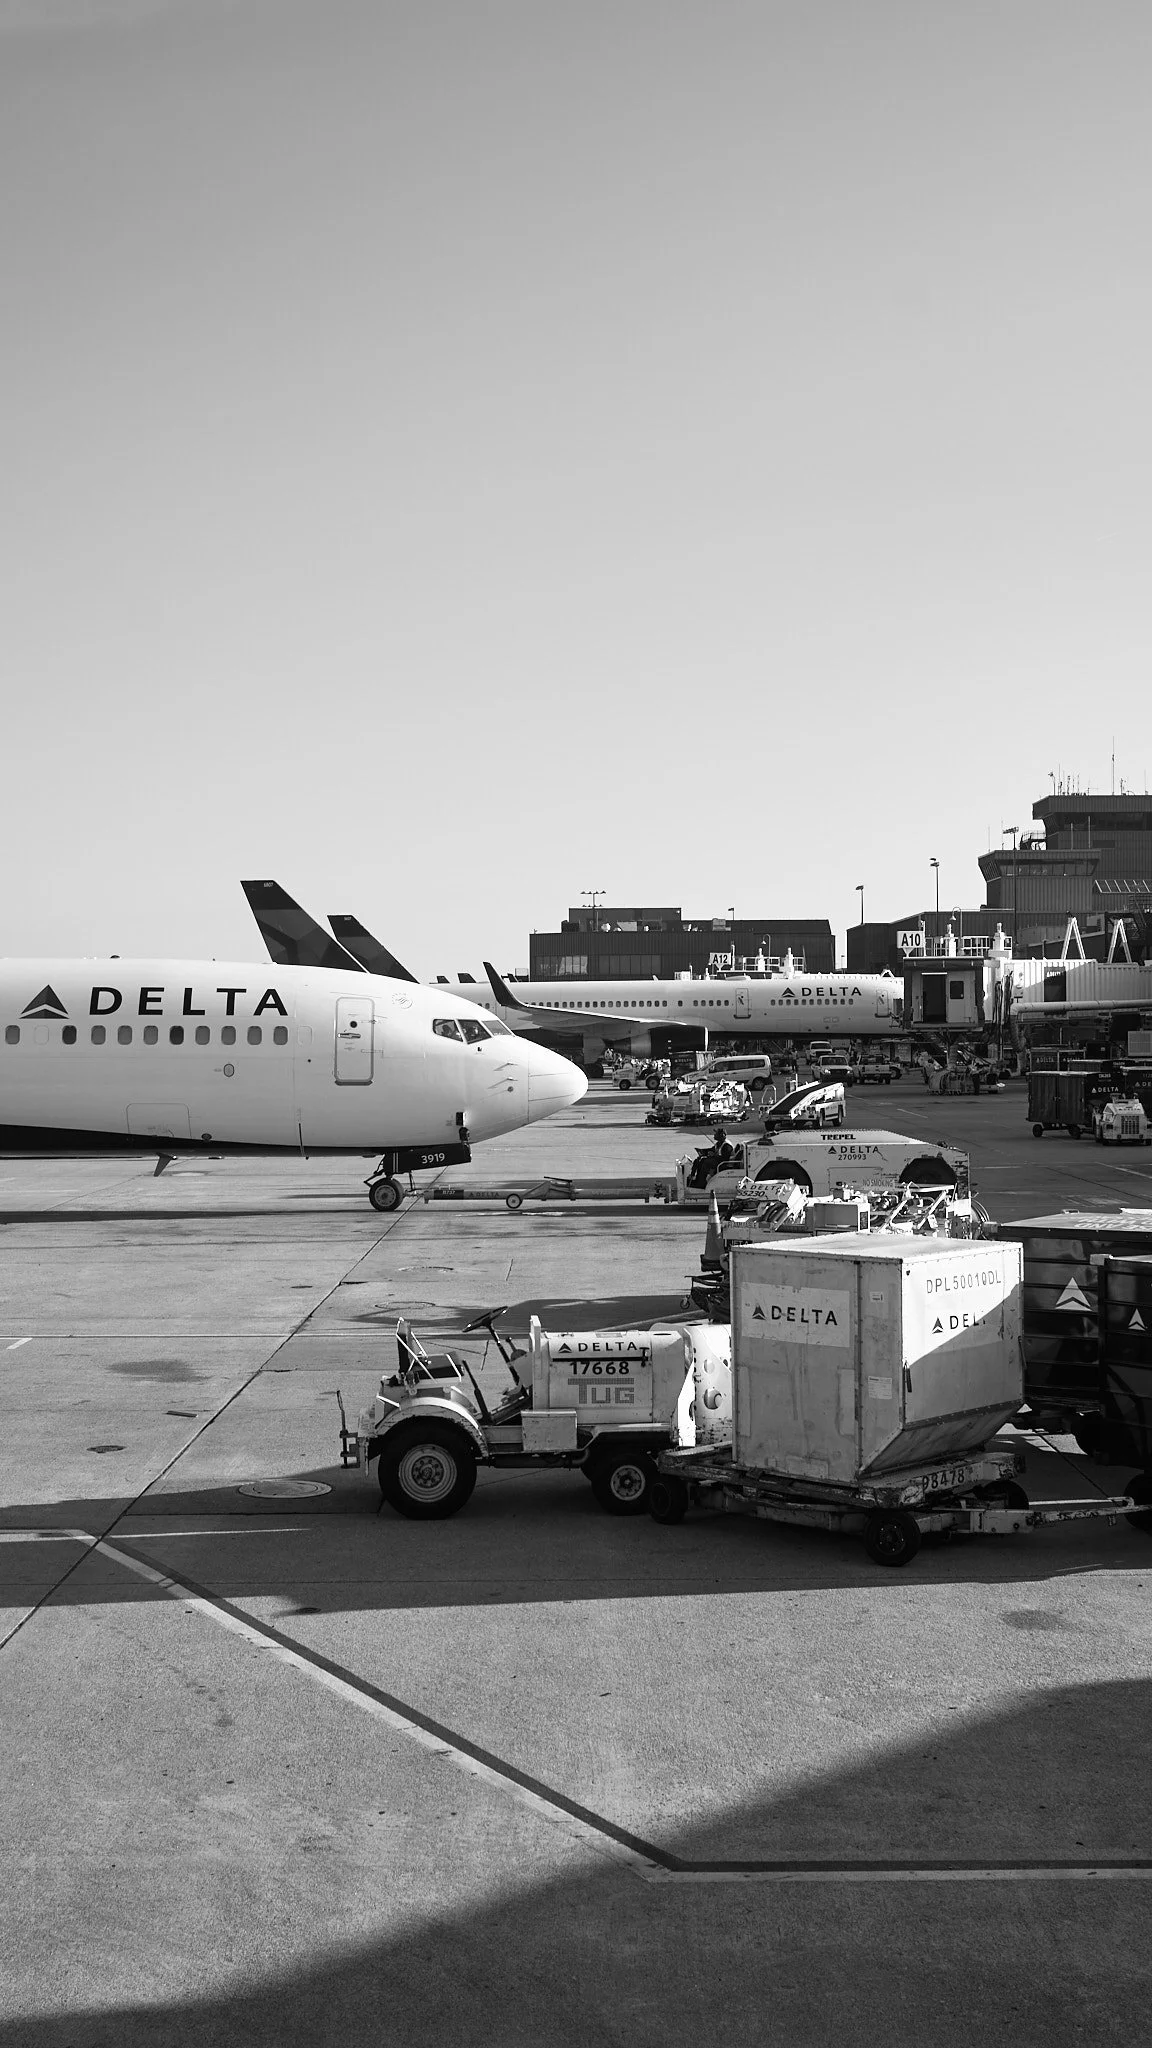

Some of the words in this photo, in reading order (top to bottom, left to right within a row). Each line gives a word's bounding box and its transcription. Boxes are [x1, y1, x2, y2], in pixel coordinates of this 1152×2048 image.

[901, 933, 921, 947] A10
[712, 954, 728, 964] A12
[801, 987, 862, 997] DELTA
[88, 986, 289, 1016] DELTA
[840, 1145, 879, 1154] DELTA
[421, 1152, 446, 1164] 3919
[771, 1305, 838, 1326] DELTA
[949, 1312, 986, 1330] DEL
[578, 1341, 638, 1352] DELTA
[569, 1361, 630, 1375] 17668
[567, 1377, 635, 1405] TUG
[922, 1468, 965, 1492] 98478
